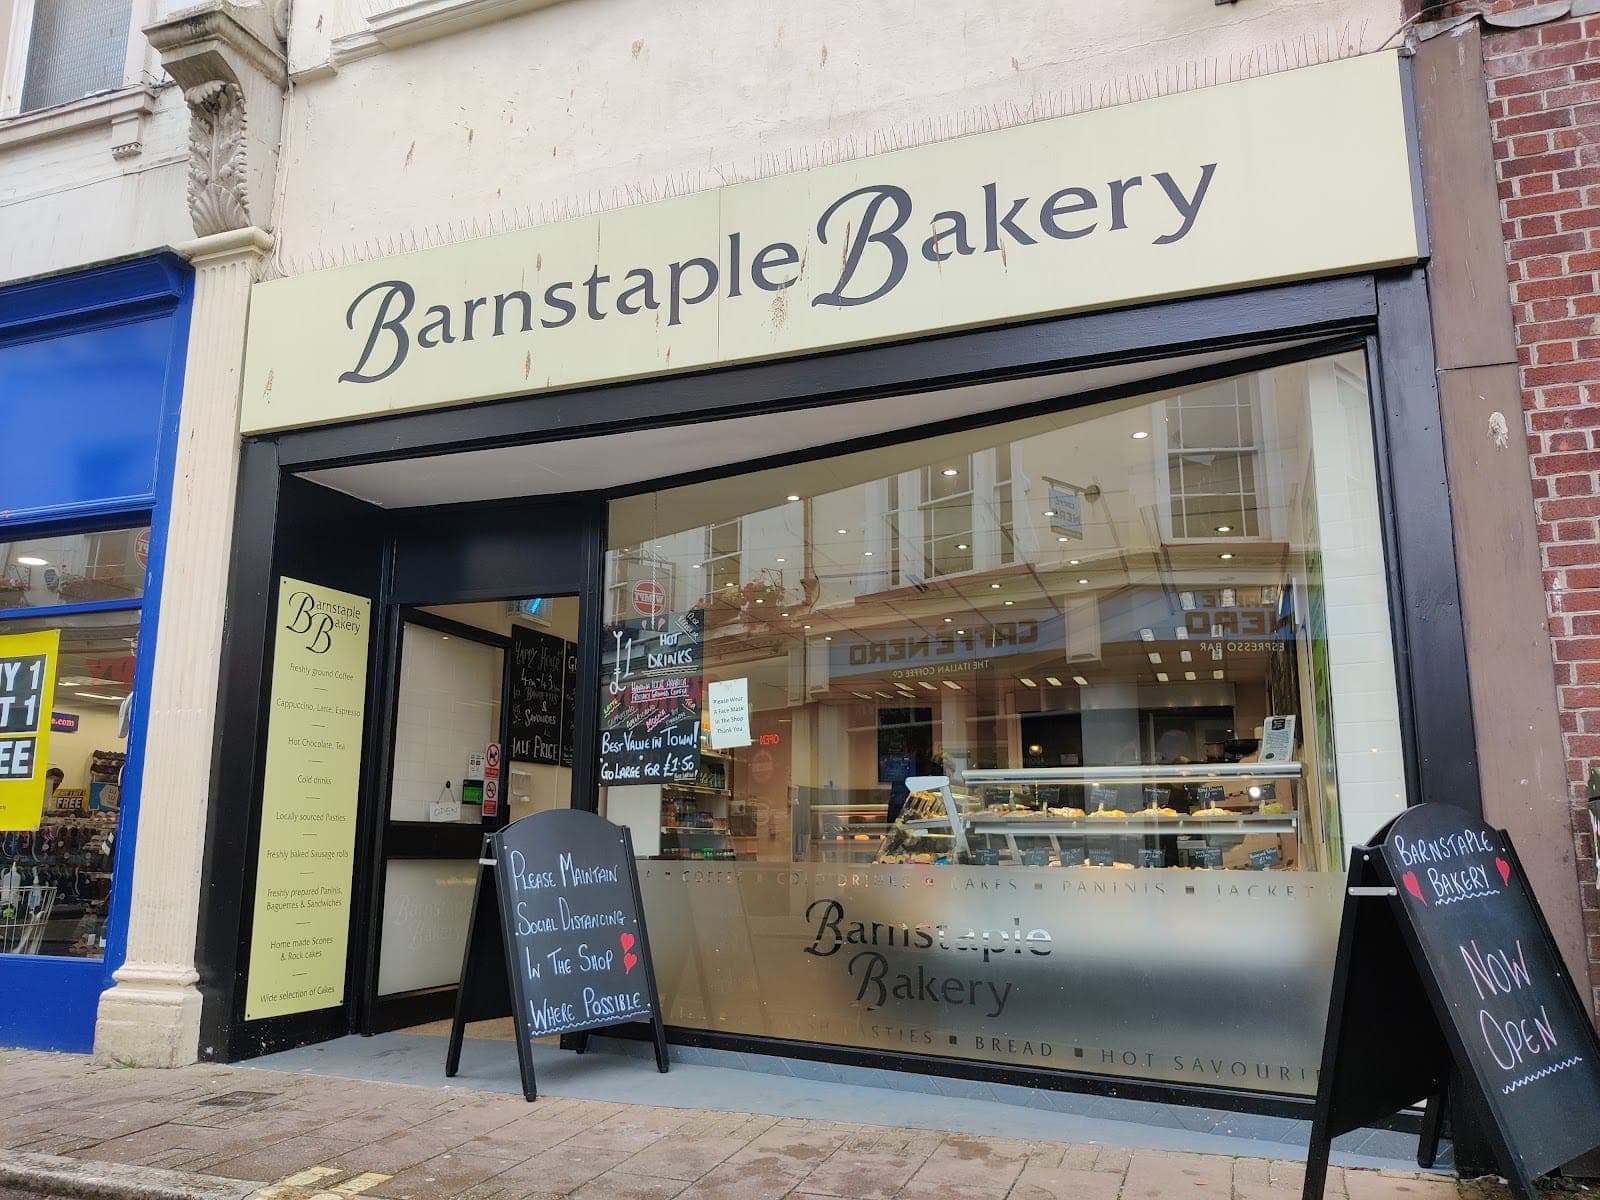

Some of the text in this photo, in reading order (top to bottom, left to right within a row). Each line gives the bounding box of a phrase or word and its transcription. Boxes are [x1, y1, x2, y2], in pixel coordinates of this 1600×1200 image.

[338, 163, 1218, 384] Barnstaple Bakery
[286, 591, 361, 634] Barnstaple
[305, 612, 361, 654] Bakery
[660, 632, 682, 647] HOT
[289, 662, 354, 681] Freshly ground Coffee
[647, 648, 693, 669] DRINKS
[29, 660, 41, 690] 1
[24, 694, 36, 726] 1
[335, 705, 361, 718] Espresso
[713, 697, 729, 705] Please
[288, 736, 300, 746] Hot
[336, 741, 345, 750] Tea
[534, 734, 559, 761] PRICE
[601, 720, 700, 755] BEST VALUE IN TOWN!
[297, 774, 332, 786] Cold drinks
[600, 762, 614, 780] GO
[614, 763, 641, 779] LARGE
[644, 762, 661, 778] FOR
[56, 797, 83, 810] FREE
[276, 811, 346, 822] Locally sourced Pasties
[266, 849, 349, 861] Freshly baked Sausage rolls
[1394, 828, 1494, 867] BARNSTAPLE
[510, 850, 619, 891] PLEASE MAINTAIN
[1427, 863, 1491, 898] BAKERY
[267, 888, 290, 899] Freshly
[290, 887, 319, 899] prepared
[1062, 880, 1167, 896] PANINIS
[266, 898, 342, 912] Baguettes & Sandwiches
[517, 896, 627, 937] SOCIAL DISTANCING
[270, 936, 334, 950] Home made Scones
[803, 898, 1053, 963] Barnstaple
[280, 950, 322, 961] & Rock cakes
[525, 943, 614, 980] IN THE SHOP
[1459, 938, 1532, 1001] NOW
[260, 985, 335, 1003] Wide selection of Cakes
[848, 950, 1013, 1018] Bakery
[529, 986, 642, 1030] WHERE POSSIBLE
[975, 1035, 1053, 1058] BREAD
[1101, 1049, 1156, 1068] HOT
[1479, 1005, 1558, 1071] OPEN
